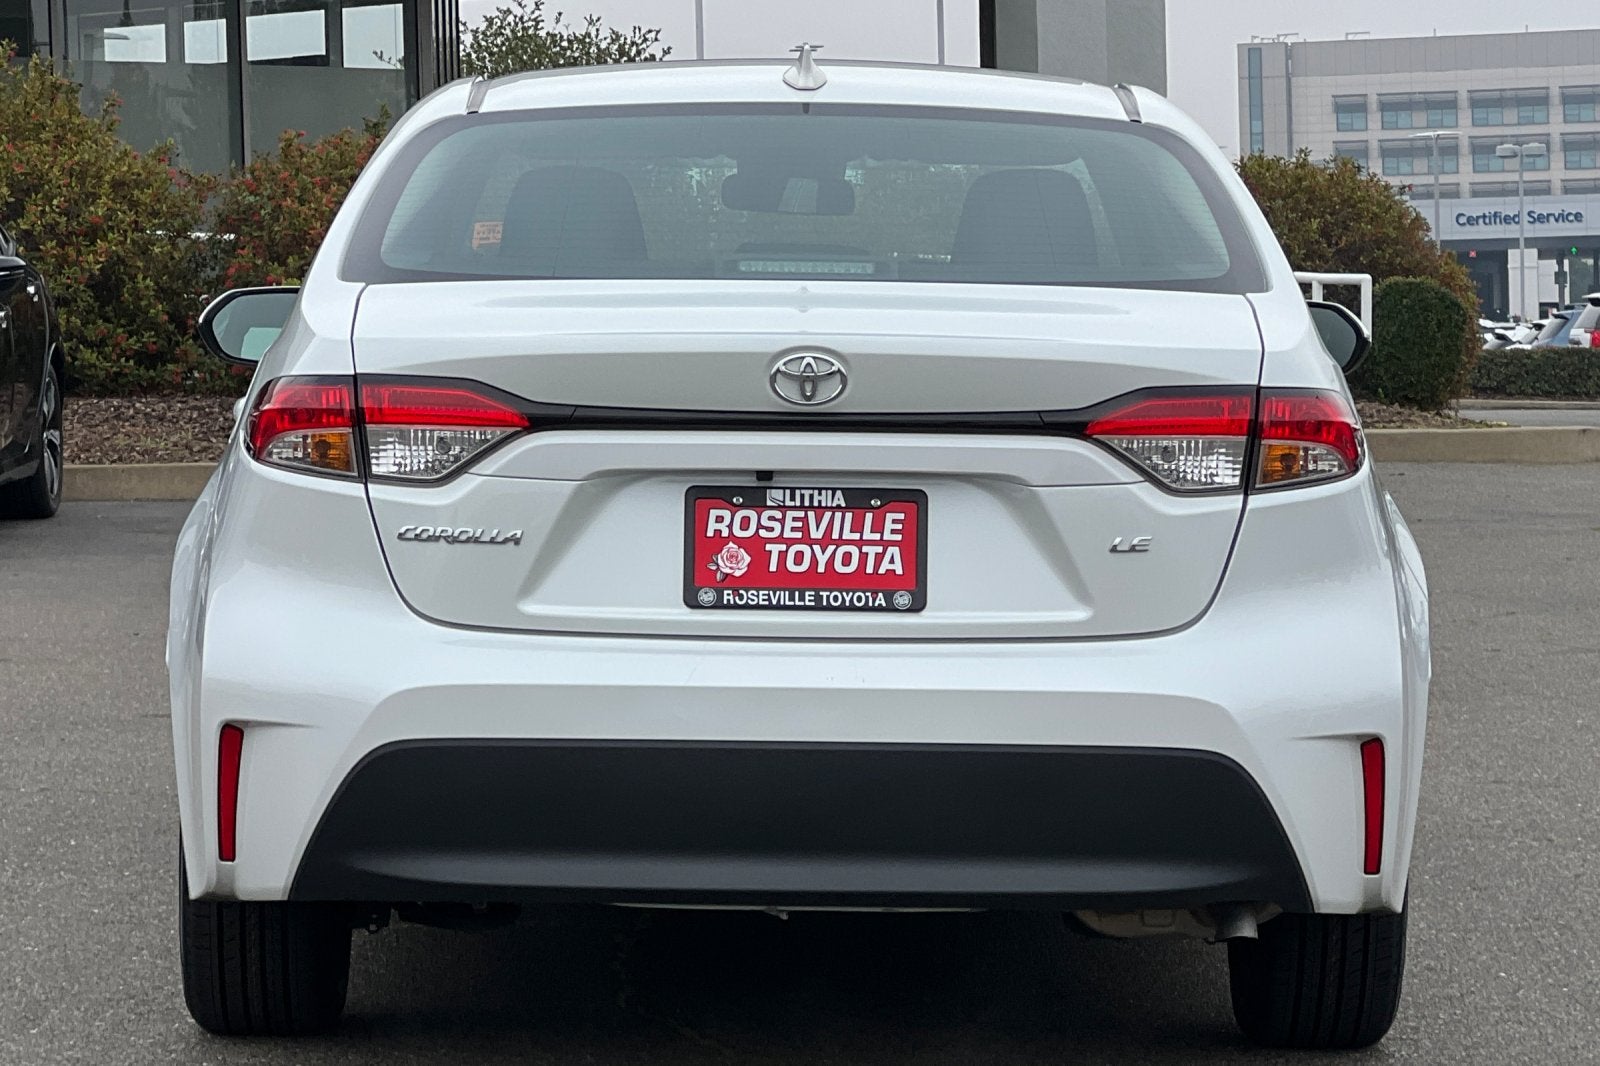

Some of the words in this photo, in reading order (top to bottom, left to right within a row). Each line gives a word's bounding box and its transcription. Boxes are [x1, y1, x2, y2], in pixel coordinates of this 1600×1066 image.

[1455, 211, 1521, 226] Certified
[1527, 209, 1584, 224] Service
[784, 489, 846, 507] LITHIA
[705, 508, 905, 541] ROSEVILLE
[397, 525, 523, 545] COROLLA
[1109, 536, 1152, 553] LE
[765, 543, 904, 575] TOYOTA
[723, 589, 815, 606] ROSEVILLE
[819, 591, 886, 607] TOYOTA
